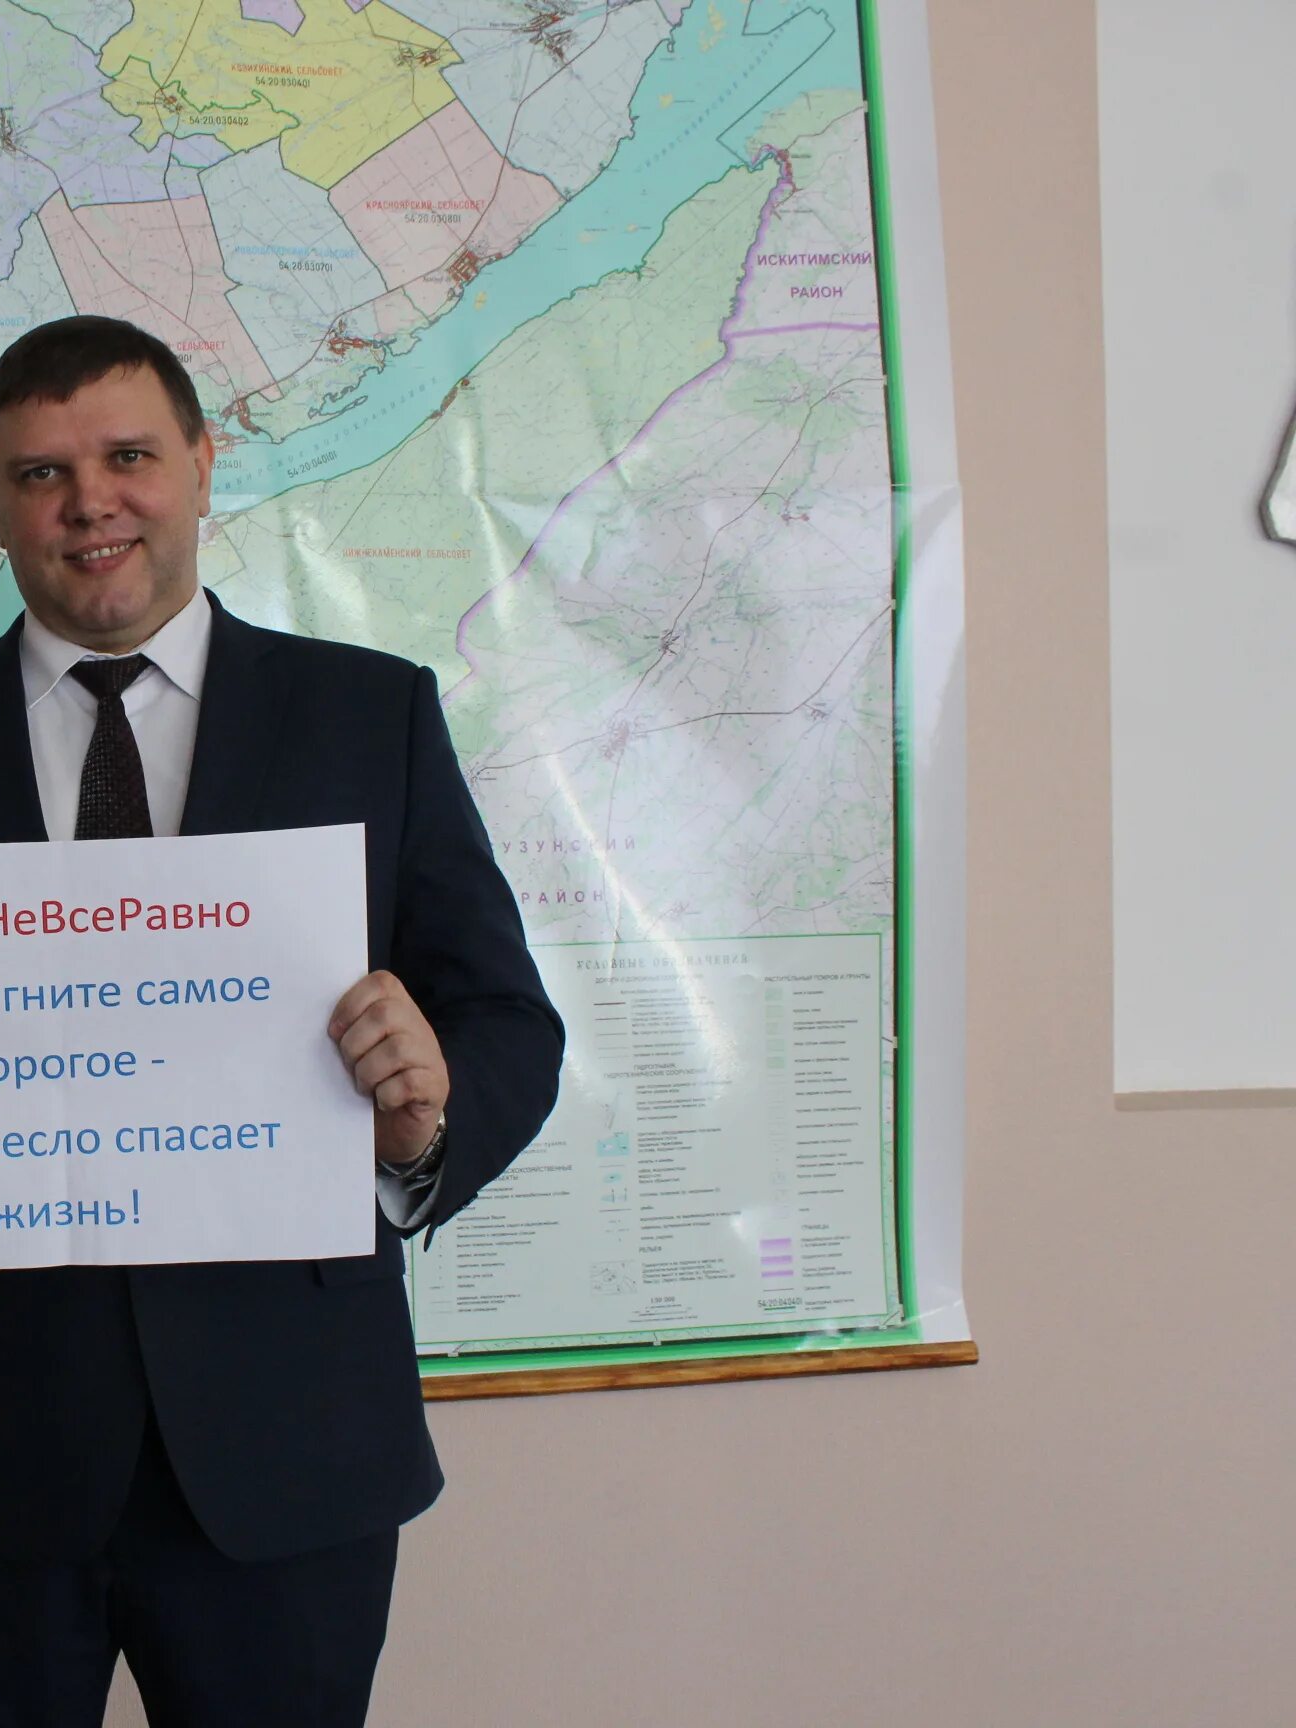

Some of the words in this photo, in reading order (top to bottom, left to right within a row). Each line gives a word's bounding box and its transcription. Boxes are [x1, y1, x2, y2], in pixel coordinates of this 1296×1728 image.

[297, 65, 344, 77] СЕЛЬСОВЕТ
[437, 200, 486, 211] СЕЛЬСОВЕТ
[757, 251, 872, 266] ИСКИТИМСКИЙ
[790, 284, 843, 298] РАЙОН
[521, 888, 603, 905] РАЙОН
[135, 975, 272, 1007] самое
[114, 1119, 282, 1156] спасает
